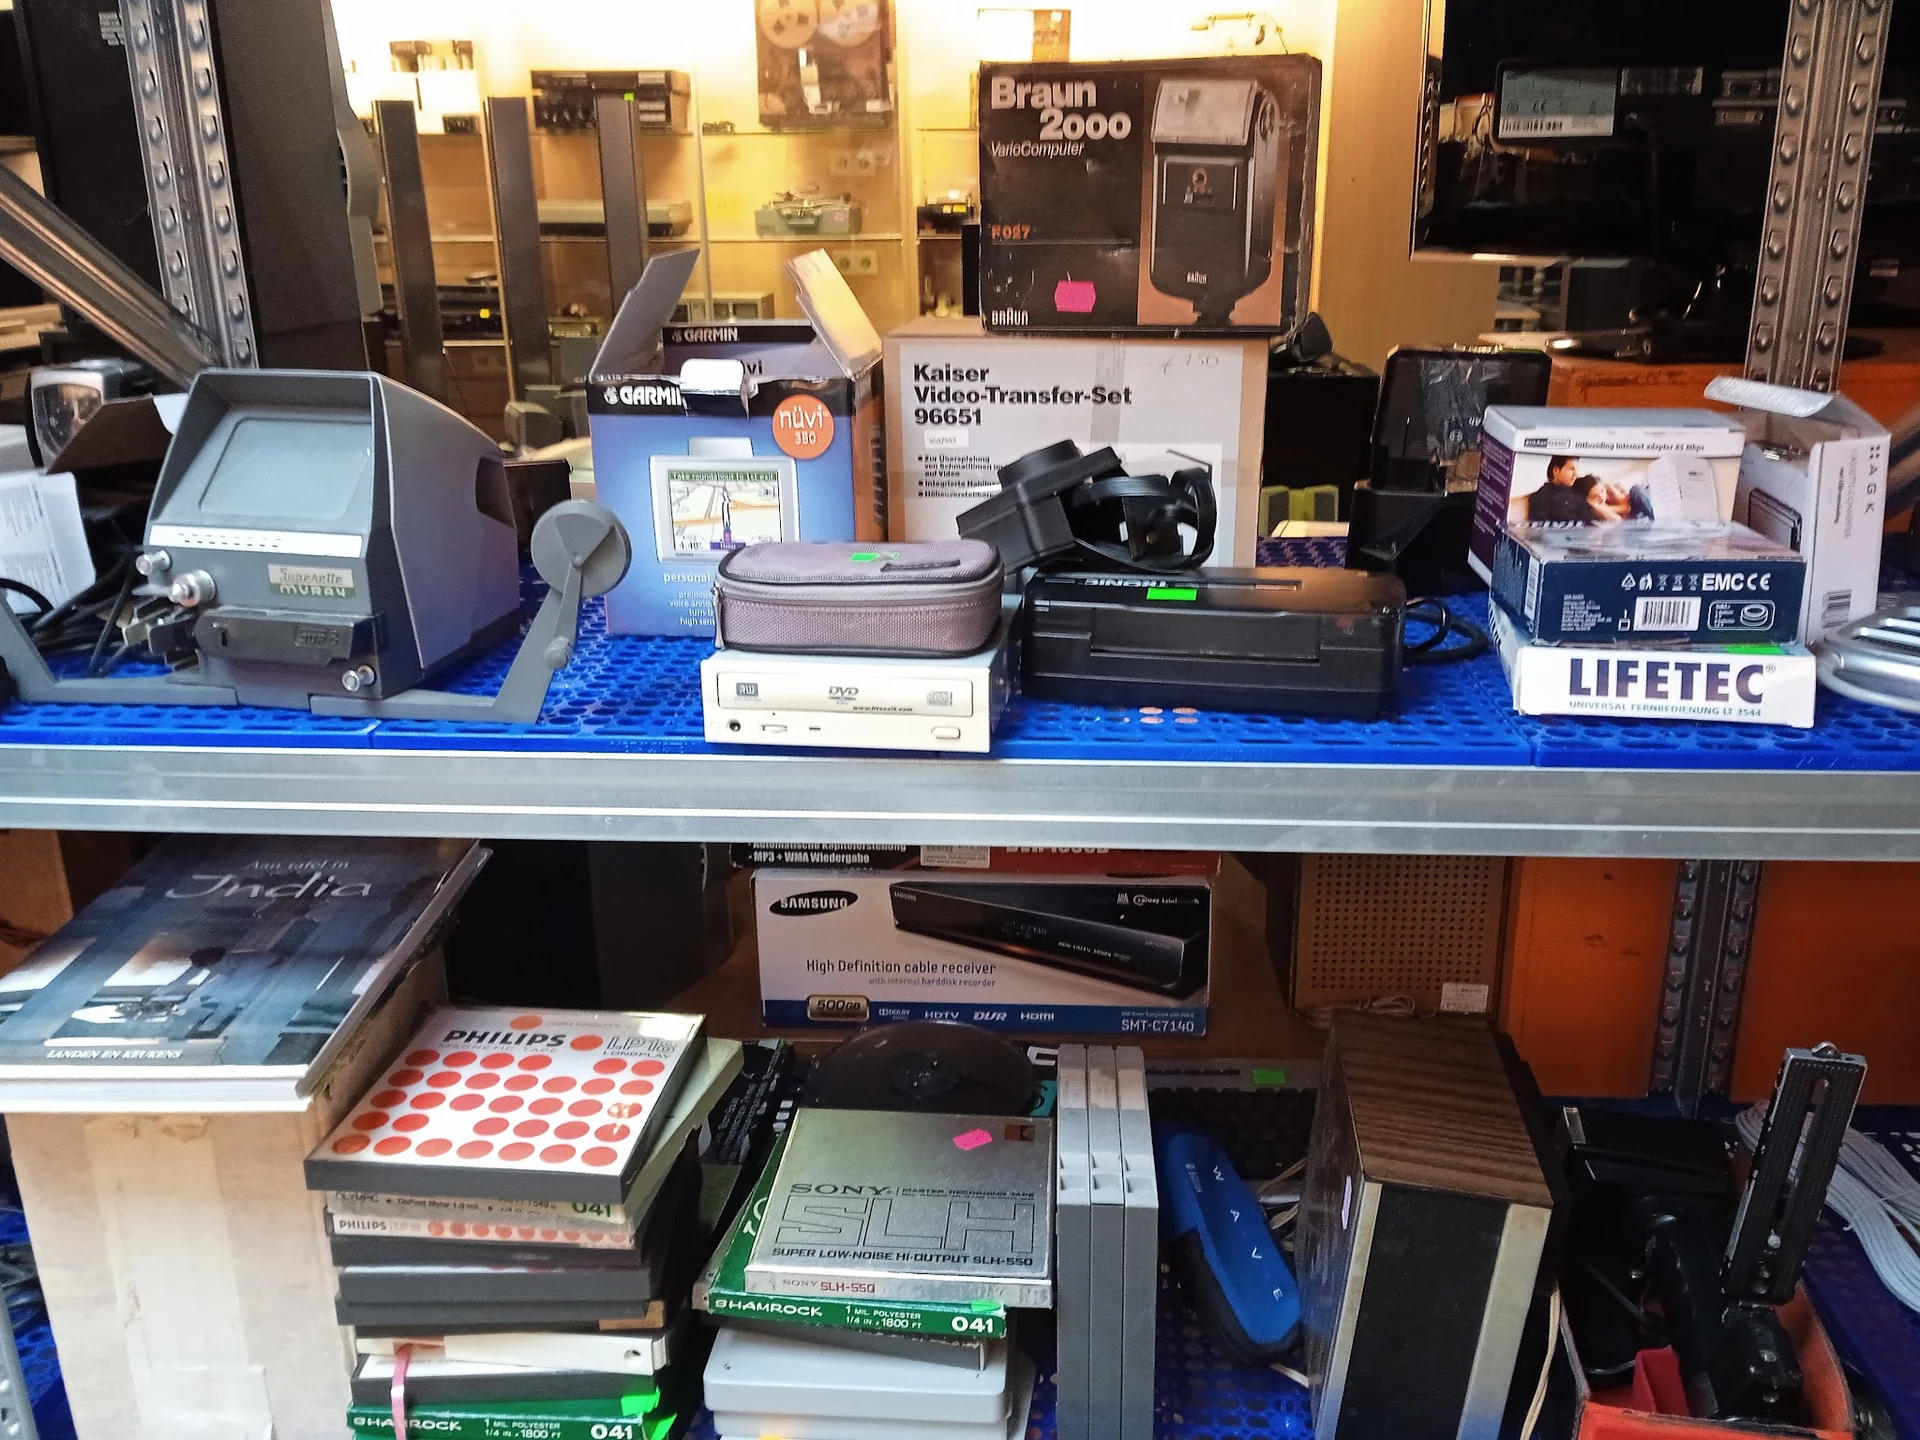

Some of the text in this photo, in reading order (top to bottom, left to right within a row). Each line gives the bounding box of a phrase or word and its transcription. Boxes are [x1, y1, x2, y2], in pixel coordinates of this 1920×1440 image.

[991, 76, 1096, 109] Braun
[1039, 108, 1132, 140] 2000
[991, 141, 1085, 158] VarioComputer
[991, 307, 1029, 326] BRAUN
[684, 327, 739, 343] GARMIN
[914, 363, 989, 382] Kaiser
[914, 386, 1132, 405] Video-Transfer-Set
[779, 404, 824, 430] nüvi
[914, 408, 982, 426] 96651
[664, 572, 711, 584] personal
[1702, 574, 1744, 591] EMC
[829, 686, 859, 697] DVD
[1569, 701, 1762, 717] UNIVERSAL FERNBEDIENUNG LT 3544
[753, 851, 775, 863] MP3
[784, 851, 809, 863] WMA
[810, 852, 870, 864] Wiedergabe
[165, 871, 372, 899] India
[780, 897, 848, 909] SAMSUNG
[806, 959, 996, 975] High Definition cable receiver
[888, 978, 920, 986] internal
[921, 978, 957, 986] harddisk
[958, 979, 996, 987] recorder
[816, 999, 861, 1011] 500GB
[925, 1011, 959, 1020] HDTV
[973, 1012, 1008, 1021] DVR
[1020, 1012, 1055, 1020] HDMI
[1121, 1019, 1194, 1032] SMT-C7140
[443, 1030, 566, 1047] PHILIPS
[46, 1050, 100, 1059] LANDEN
[791, 1183, 888, 1195] SONY
[572, 1202, 611, 1218] 041
[340, 1220, 387, 1230] PHILIPS
[775, 1195, 1036, 1253] SLH
[772, 1247, 816, 1258] SUPER
[972, 1255, 1034, 1267] SLH-550
[783, 1279, 876, 1293] SONY SLH-550
[715, 1299, 823, 1316] SHAMROCK
[873, 1309, 922, 1320] POLYESTER
[951, 1316, 994, 1333] 041
[846, 1316, 861, 1325] 1/4
[881, 1317, 909, 1329] 1800
[911, 1321, 923, 1330] FT
[353, 1416, 462, 1432] SHAROCK
[512, 1421, 561, 1430] POLYESTER
[591, 1423, 634, 1440] 041
[484, 1428, 499, 1437] 1/4
[521, 1429, 549, 1440] 1800
